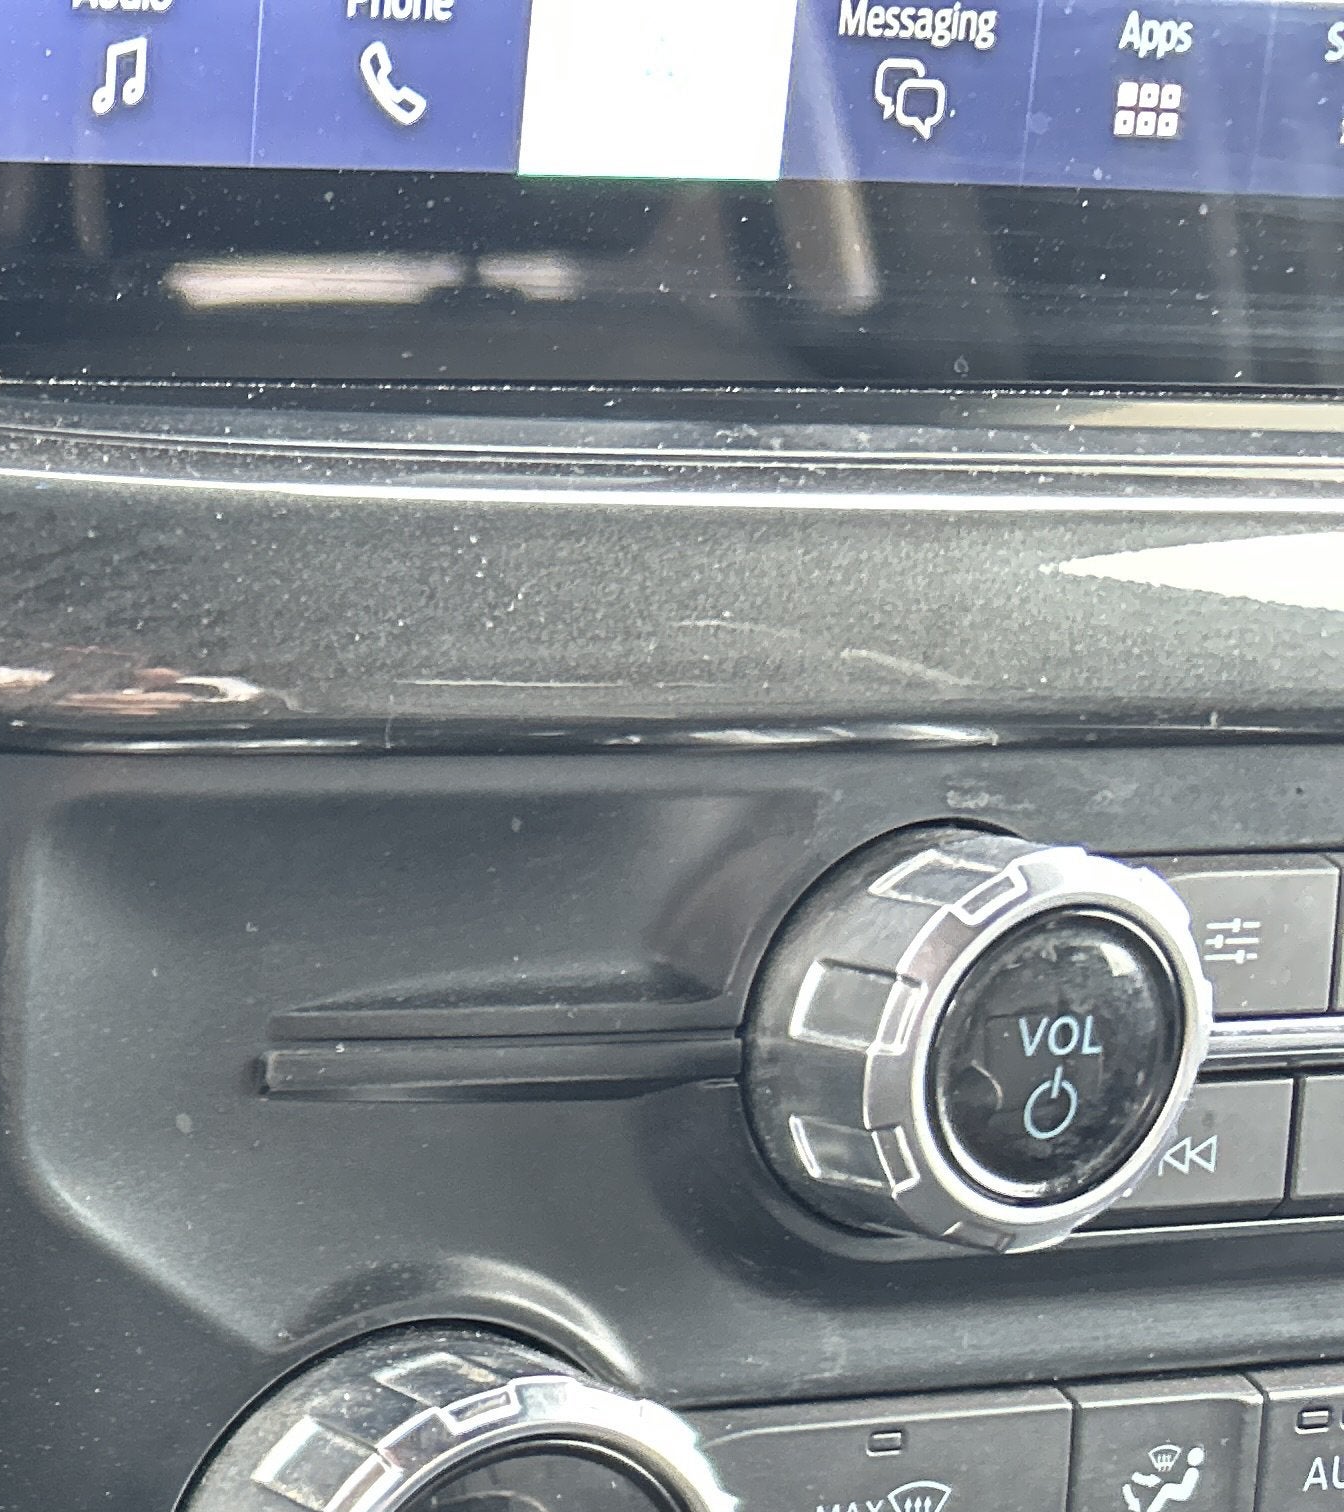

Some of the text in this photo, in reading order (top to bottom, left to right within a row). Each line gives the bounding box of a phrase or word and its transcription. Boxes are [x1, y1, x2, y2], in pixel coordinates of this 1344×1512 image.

[837, 0, 1000, 50] Messaging
[1118, 10, 1194, 59] Apps
[1018, 1013, 1104, 1057] VOL
